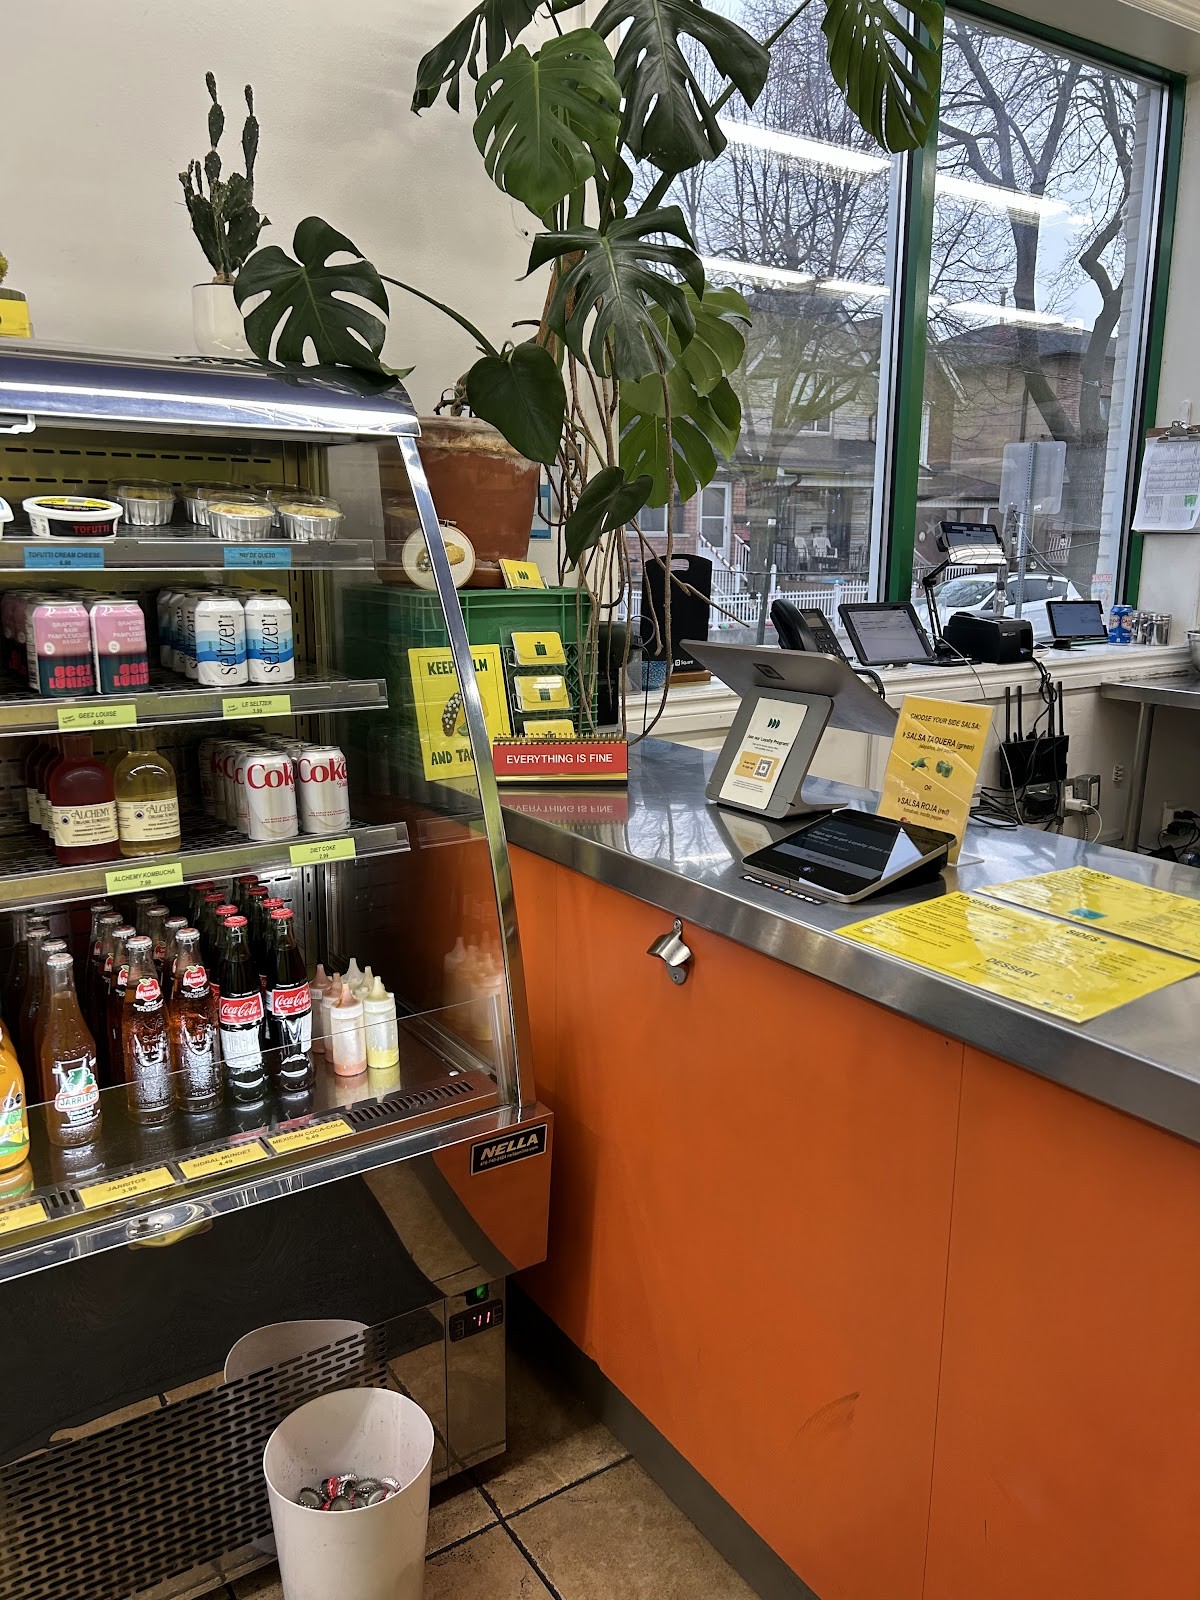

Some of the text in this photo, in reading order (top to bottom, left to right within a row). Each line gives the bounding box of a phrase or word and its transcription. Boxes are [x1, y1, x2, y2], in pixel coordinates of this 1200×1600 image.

[72, 525, 110, 535] TOFUTTI
[77, 551, 101, 559] CHEESE
[119, 661, 149, 677] gee
[426, 660, 454, 676] KEEP
[249, 699, 273, 707] SELTZER
[78, 711, 95, 719] GEEZ
[95, 710, 117, 718] LOUISE
[92, 718, 105, 726] 4.99
[910, 712, 982, 730] CHOOSE YOUR SIDE SALSA:
[905, 731, 926, 742] SALSA
[926, 735, 956, 748] TAQUERA
[431, 750, 453, 766] AND
[506, 753, 613, 764] EVERYTHING IS FINE
[247, 762, 295, 790] Cok
[70, 807, 111, 820] ALCHEMY
[900, 797, 950, 816] SALSA ROJA (red)
[309, 844, 336, 854] DIET COKE
[113, 868, 176, 882] ALCHEMY KOMBUCHA
[968, 898, 1005, 912] SHARE
[1066, 928, 1101, 942] SIDES
[985, 957, 1040, 978] DESSERT
[59, 1091, 97, 1107] JARRITOS
[272, 1122, 345, 1146] MEXICAN COCA-COLA
[480, 1133, 540, 1161] NELLA
[192, 1148, 251, 1169] SIDRAL MUNDET
[106, 1176, 147, 1193] JARRITOS
